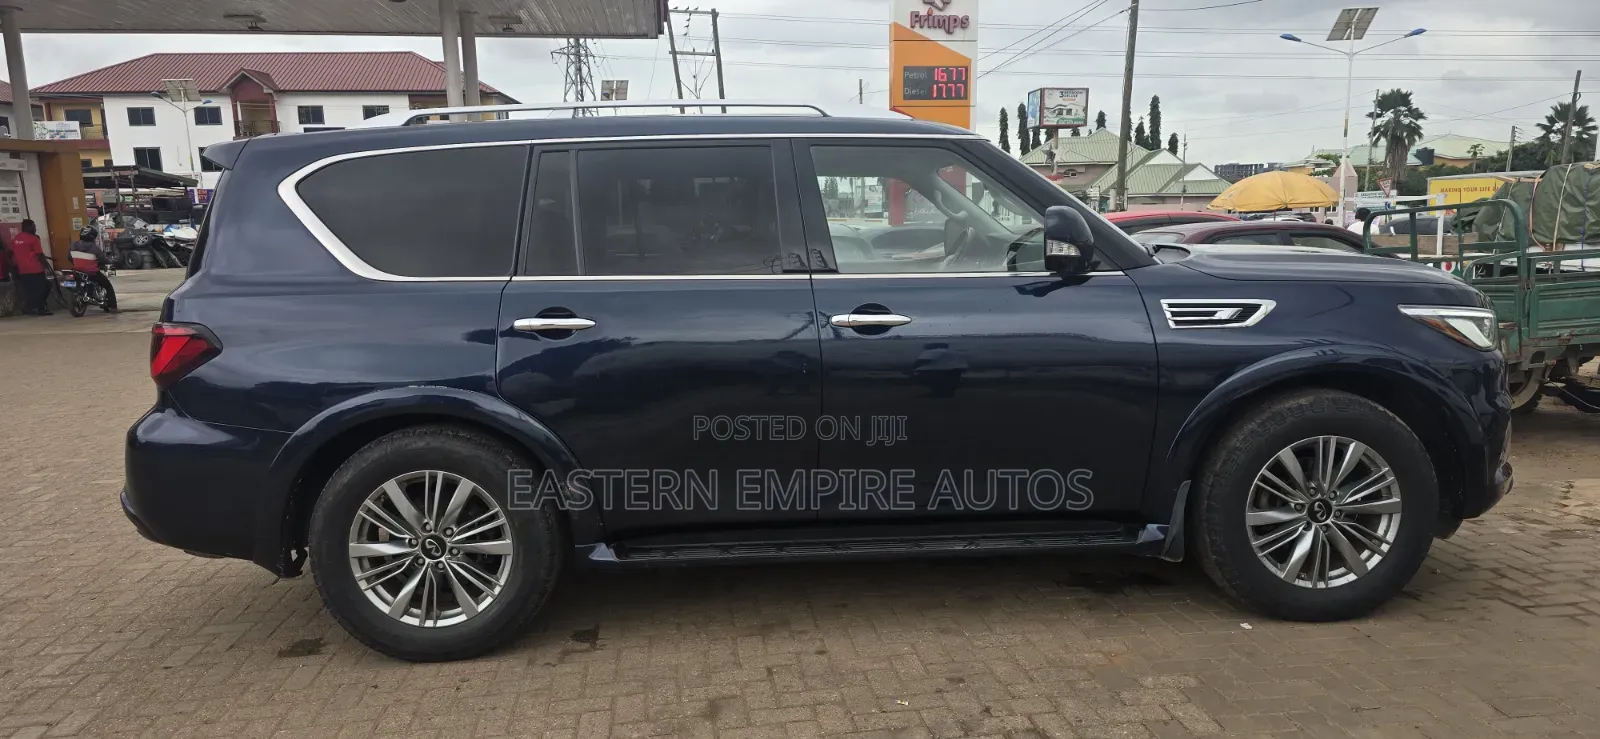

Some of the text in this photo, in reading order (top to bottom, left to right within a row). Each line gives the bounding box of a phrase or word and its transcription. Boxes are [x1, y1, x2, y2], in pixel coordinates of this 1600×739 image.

[910, 8, 970, 34] Frimps
[904, 67, 966, 82] Petrol 1677
[904, 83, 965, 98] Diesel 1777
[1059, 90, 1064, 98] 3
